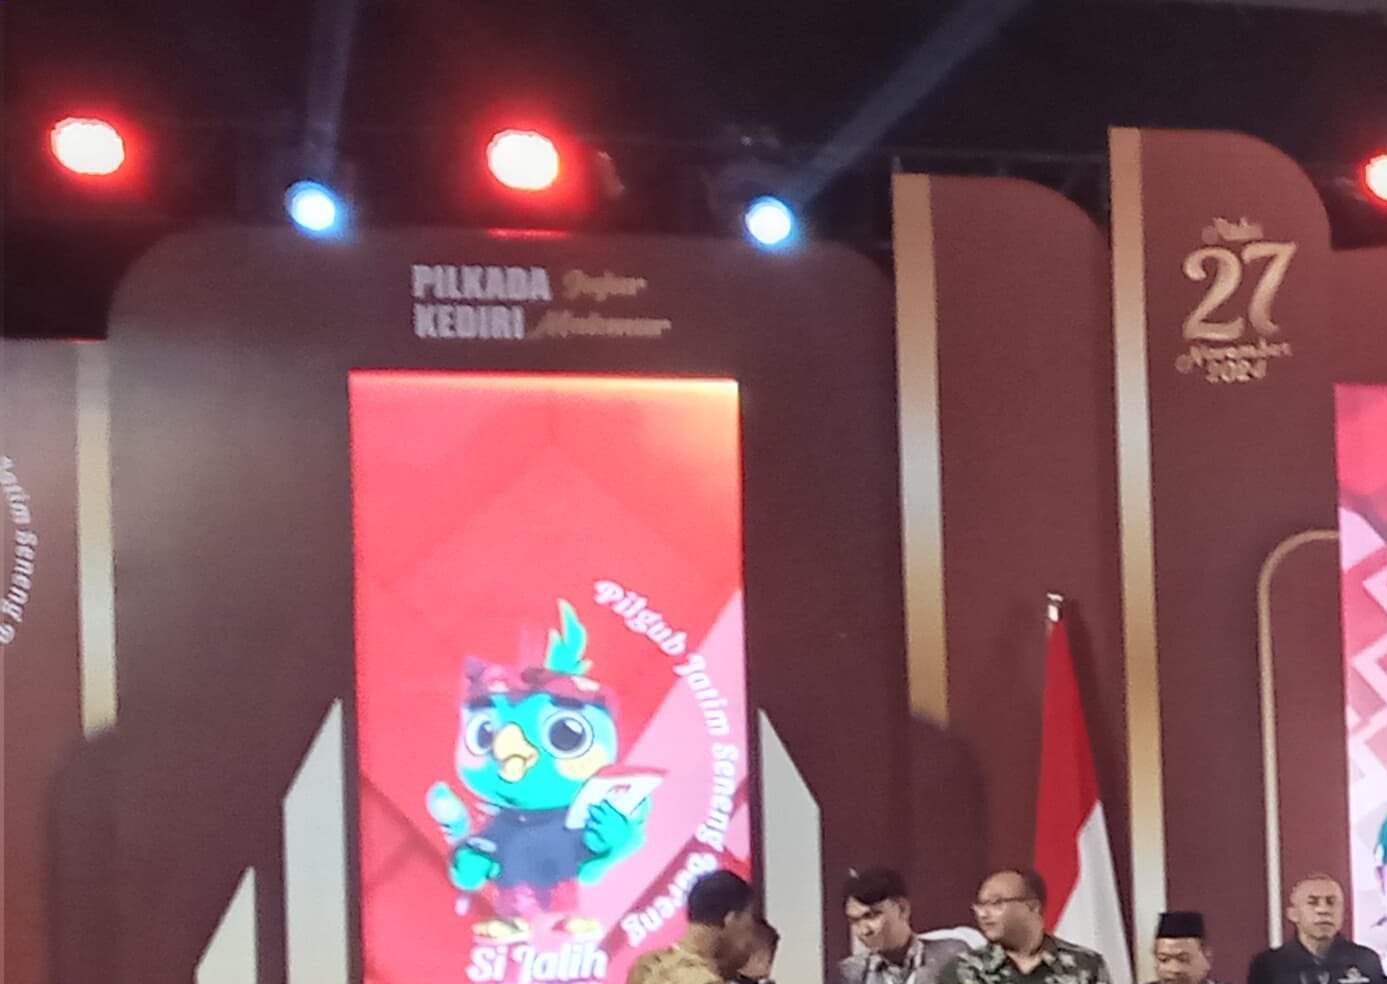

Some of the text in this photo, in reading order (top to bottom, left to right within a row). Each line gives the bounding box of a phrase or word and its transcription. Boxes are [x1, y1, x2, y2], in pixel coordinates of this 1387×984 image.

[411, 264, 553, 300] PILKADA
[1183, 241, 1297, 341] 27
[413, 303, 526, 339] KEDIRI
[593, 580, 688, 656] Pilgub
[671, 652, 731, 736] Jatim
[695, 742, 740, 853] Seneng
[465, 944, 508, 983] Si
